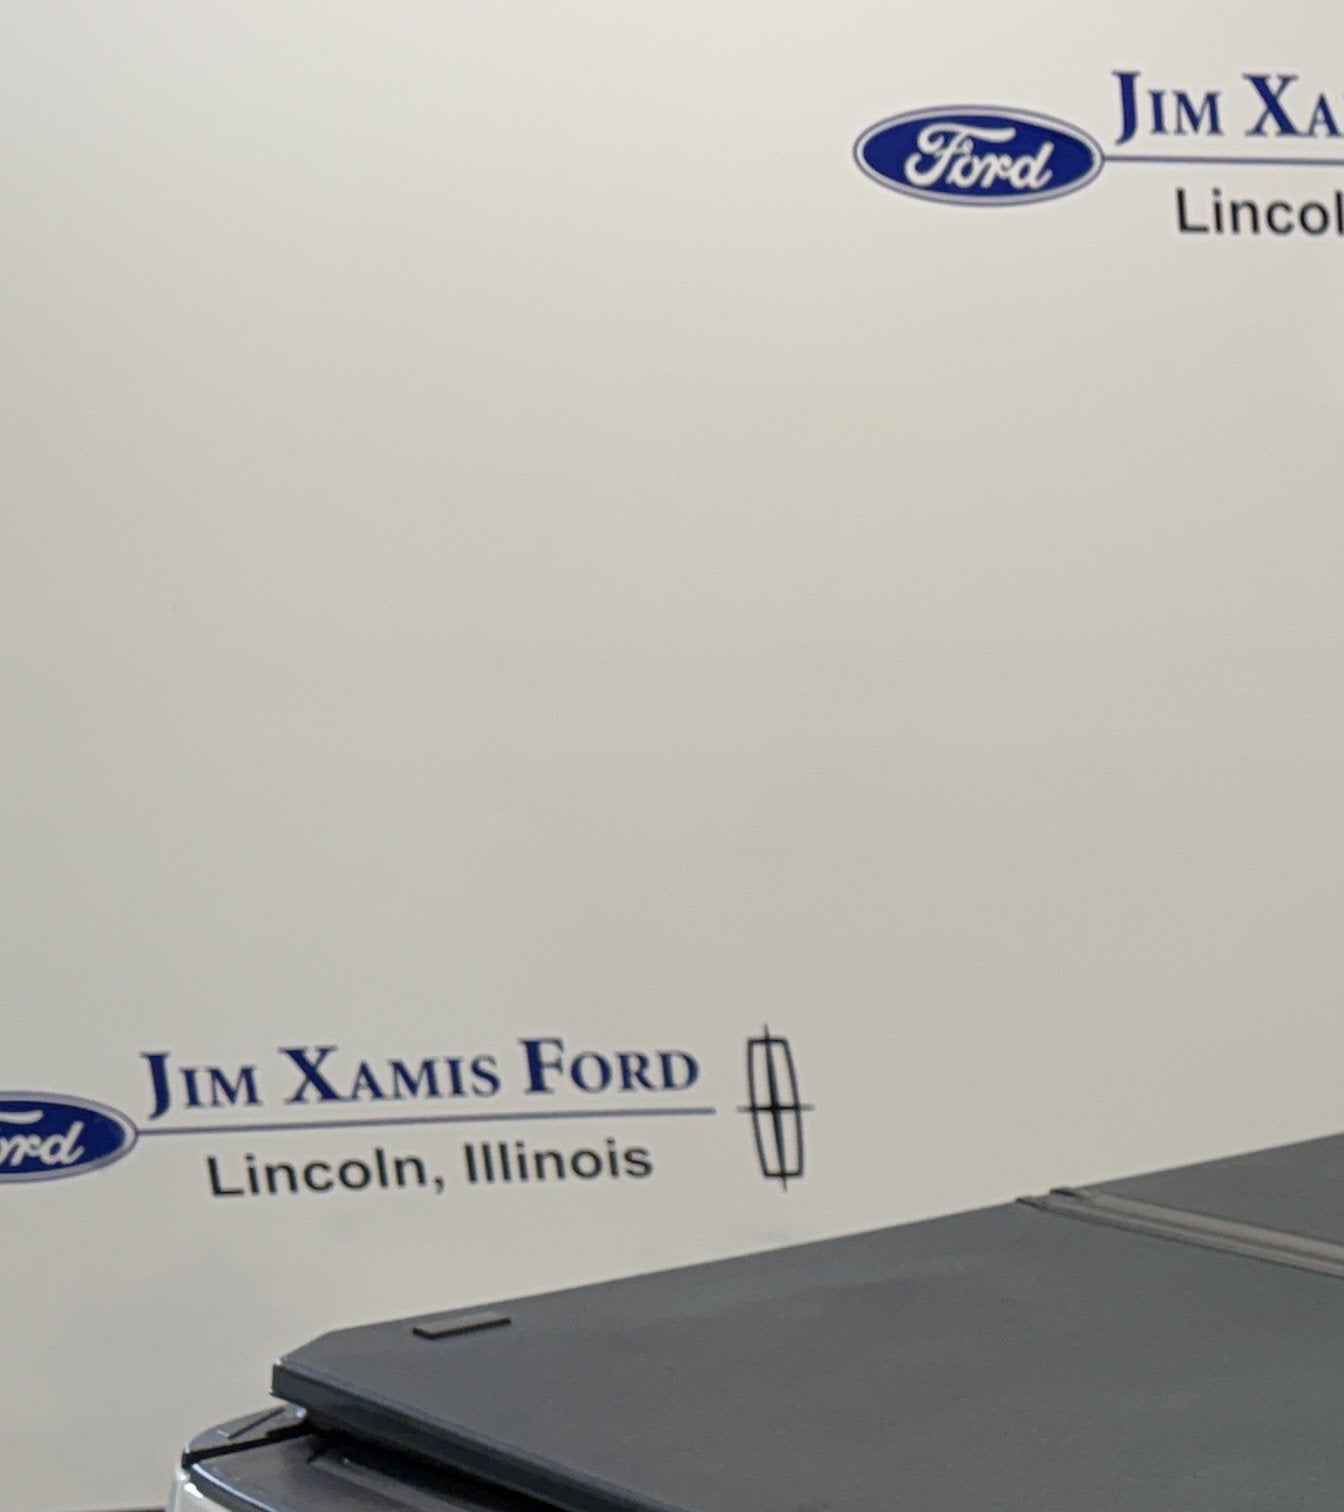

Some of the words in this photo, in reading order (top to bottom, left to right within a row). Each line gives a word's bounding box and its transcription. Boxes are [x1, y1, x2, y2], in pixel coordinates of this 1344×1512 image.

[1111, 70, 1223, 147] JIM
[903, 121, 1054, 190] Ford
[140, 1050, 264, 1120] JIM
[277, 1044, 503, 1106] XAMIS
[519, 1036, 702, 1097] FORD
[0, 1109, 86, 1167] rd
[206, 1145, 446, 1198] Lincoln,
[464, 1138, 655, 1185] Illinois
